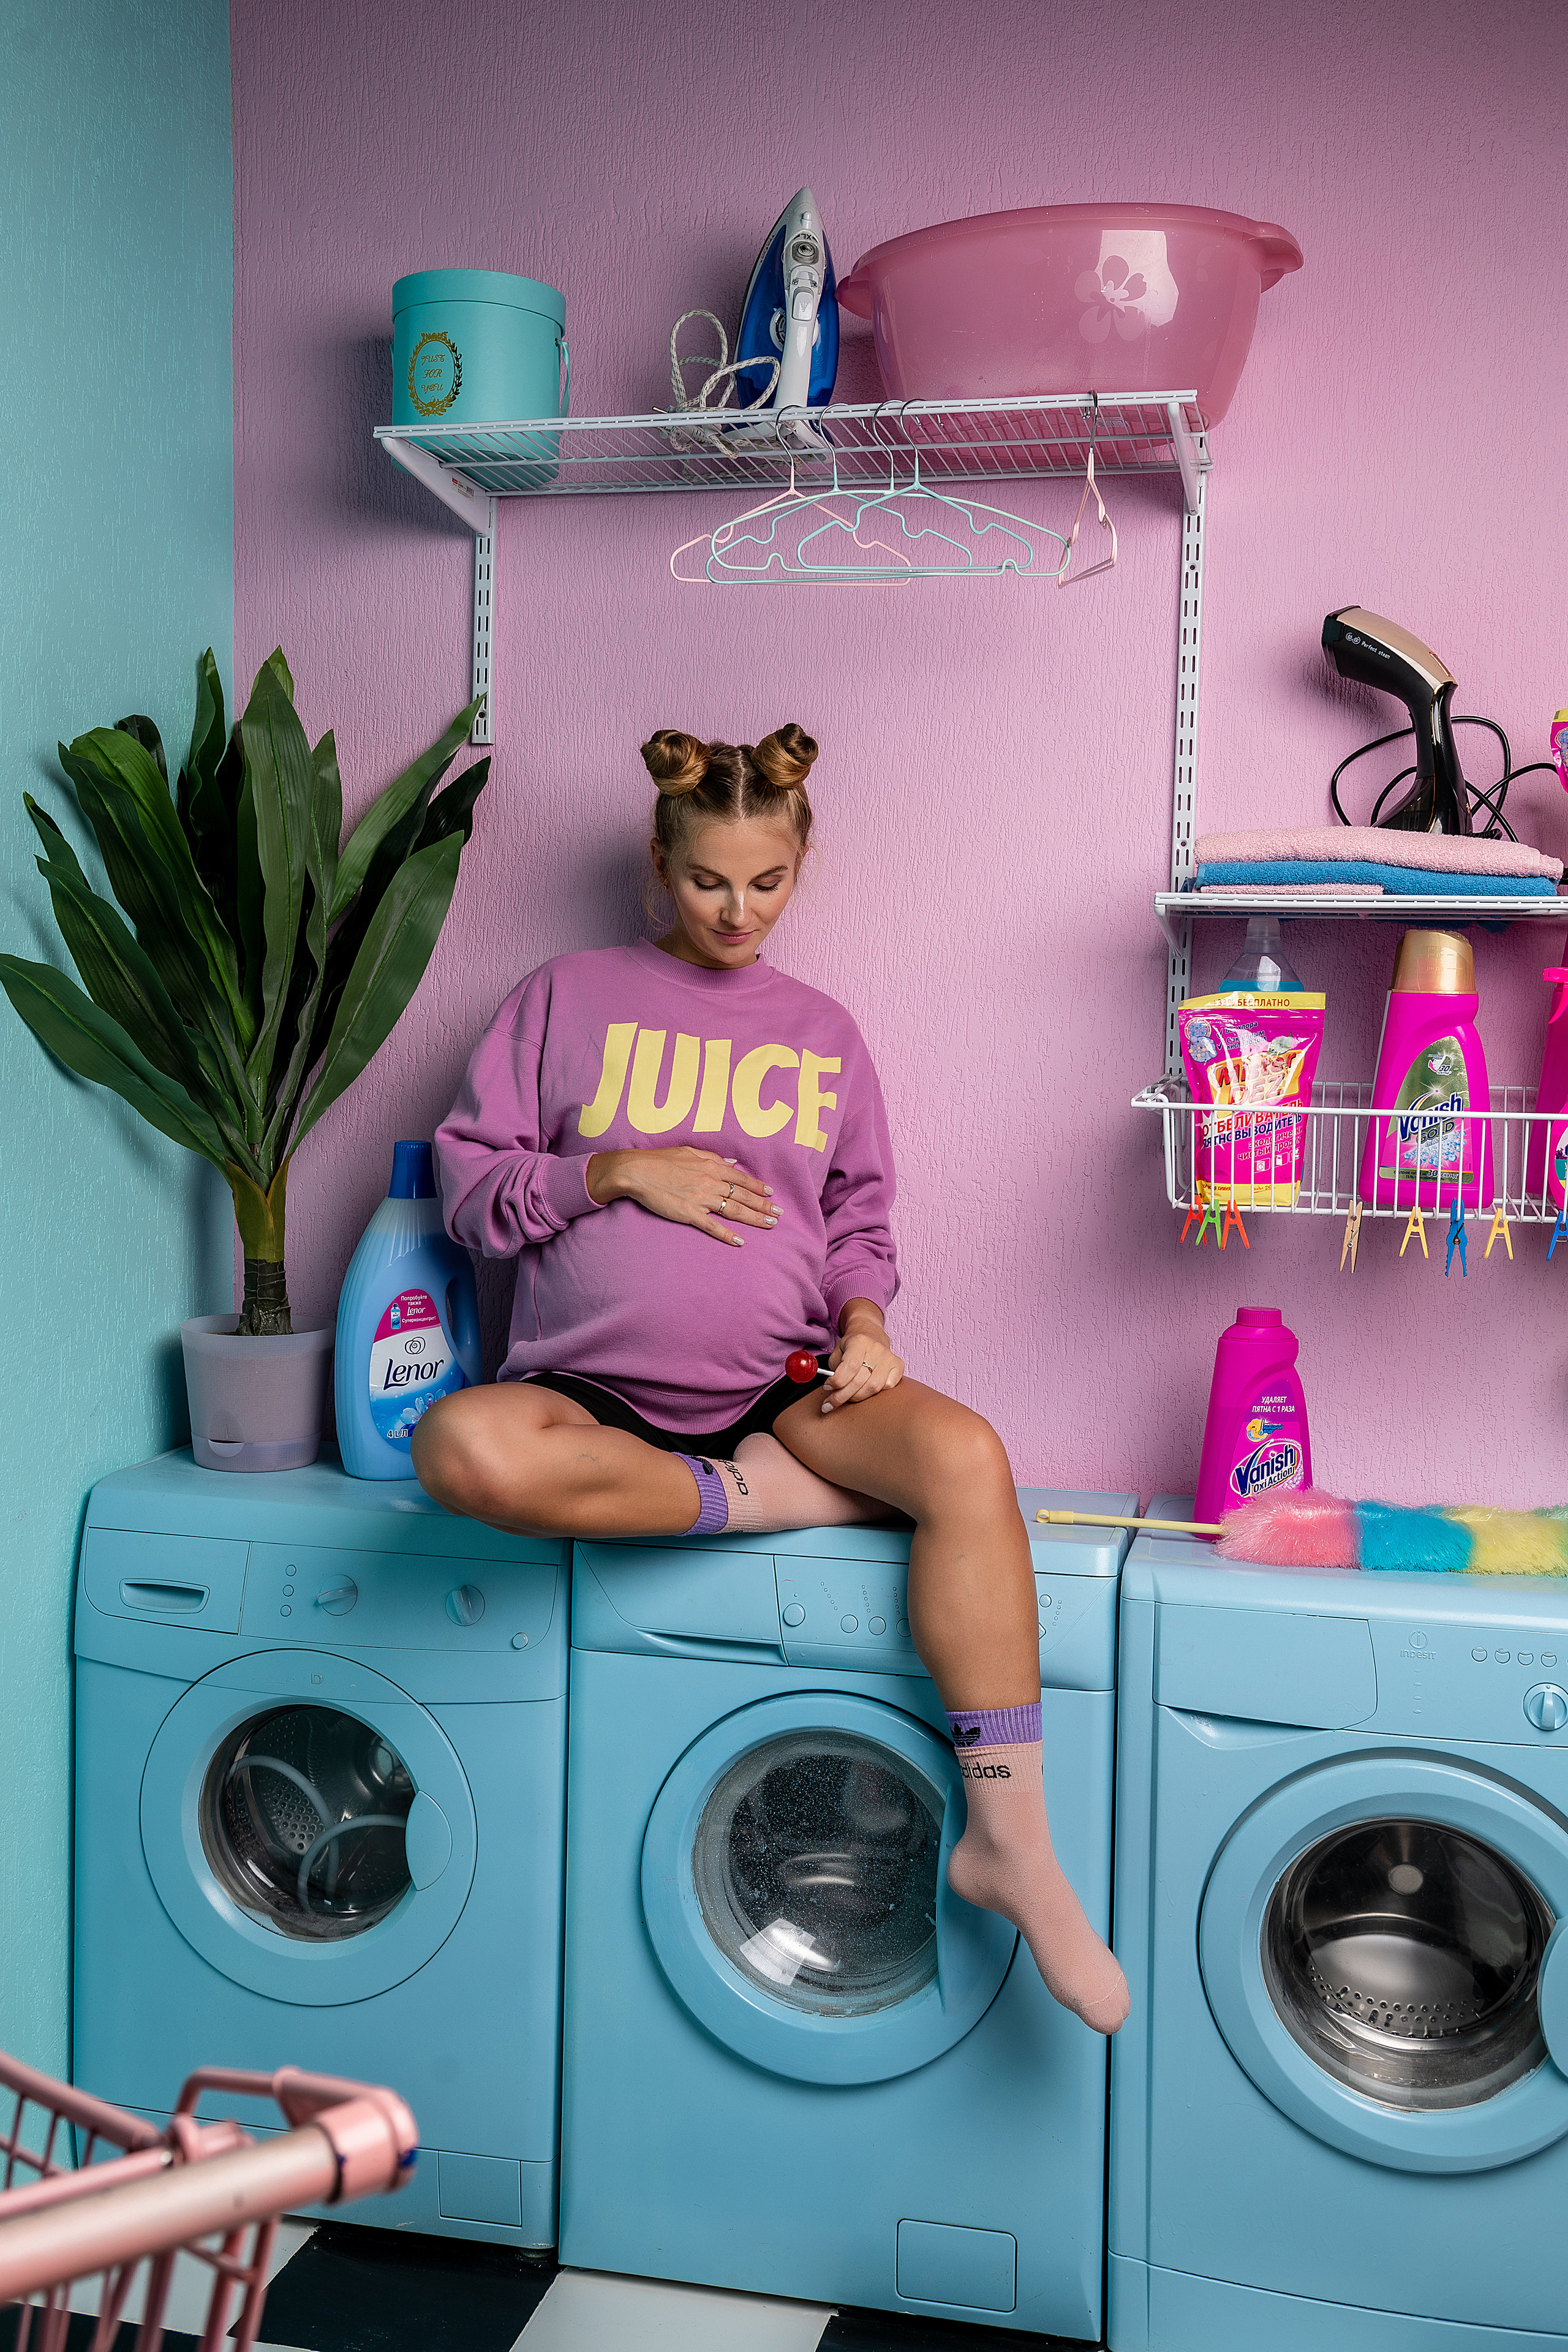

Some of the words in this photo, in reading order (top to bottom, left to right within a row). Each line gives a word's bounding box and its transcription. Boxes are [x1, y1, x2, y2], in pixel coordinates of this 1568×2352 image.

[421, 354, 446, 366] JUST
[423, 368, 442, 379] FOR
[421, 383, 444, 394] YOU
[1361, 641, 1378, 653] Perfect
[1378, 650, 1391, 659] steam
[1237, 998, 1290, 1007] БЕСПЛАТНО
[1238, 1021, 1257, 1030] хлора
[1227, 1036, 1267, 1050] кислородом
[1216, 1052, 1297, 1087] Mister
[578, 1022, 842, 1153] JUICE
[1229, 1072, 1286, 1106] DEZ
[1202, 1099, 1303, 1137] ОБЕЛИВАЕЛЬ
[1400, 1091, 1464, 1142] Vanish
[1248, 1126, 1303, 1149] экологичеки
[407, 1306, 426, 1316] Lenor
[383, 1358, 445, 1391] Lenor
[1262, 1396, 1287, 1404] УДАЛЯЕТ
[387, 1430, 393, 1438] 4
[1235, 1439, 1296, 1496] Vanish
[718, 1460, 748, 1495] adid
[960, 1762, 1011, 1779] didas
